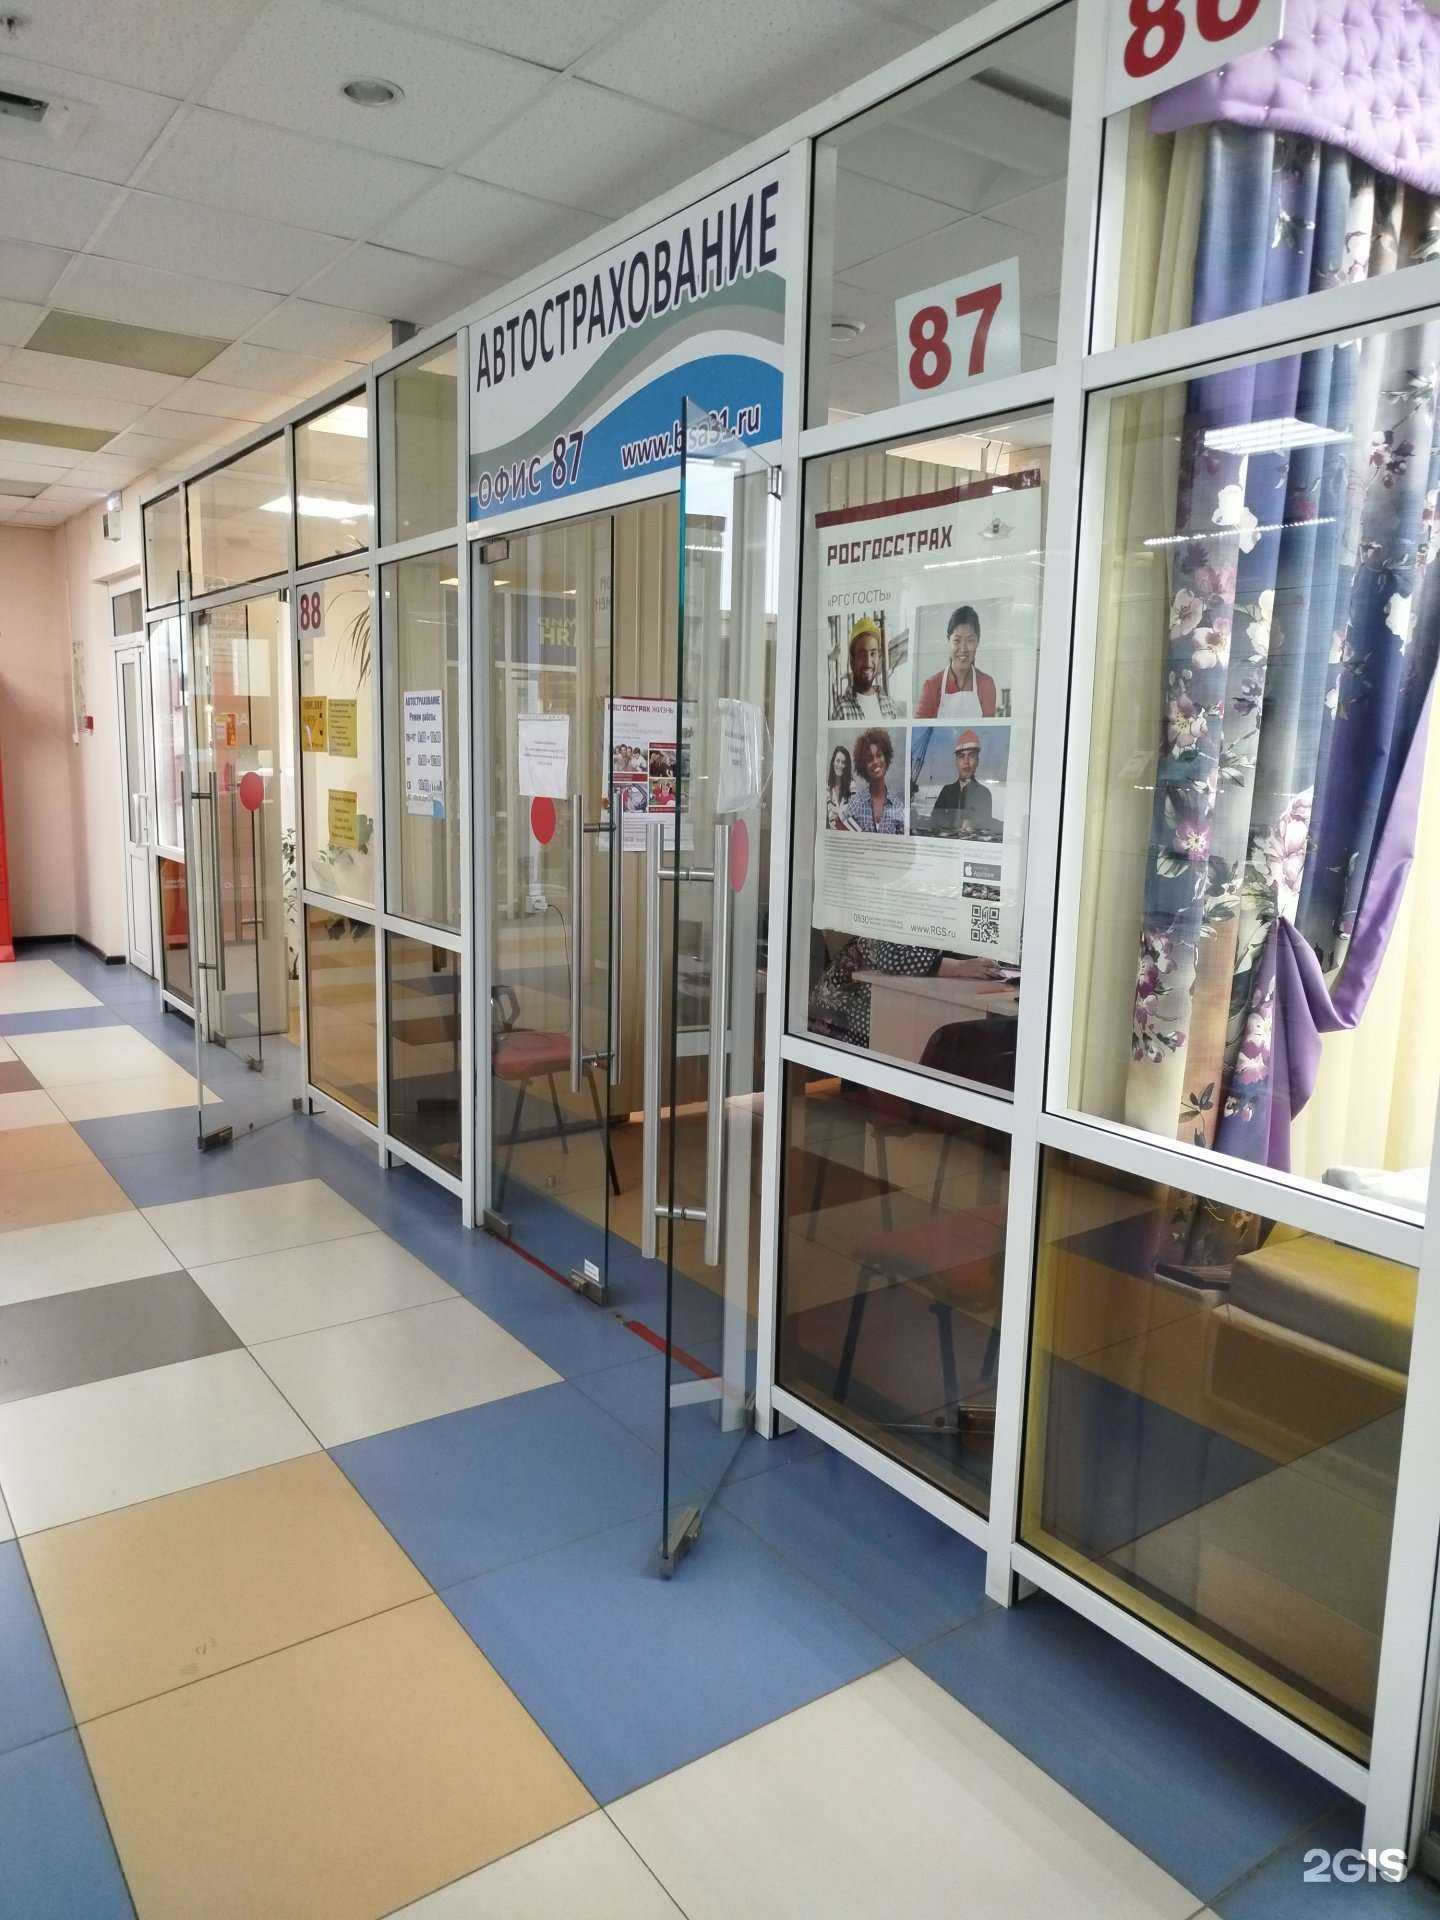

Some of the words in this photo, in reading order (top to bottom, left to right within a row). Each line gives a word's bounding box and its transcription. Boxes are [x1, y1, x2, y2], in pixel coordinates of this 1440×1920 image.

[477, 181, 779, 392] АВТОСТРАХОВАНИЕ
[909, 283, 1002, 390] 87
[478, 456, 542, 508] ОФИС
[552, 430, 584, 488] 87
[827, 525, 953, 566] РОСГОССТРАХ
[300, 591, 321, 631] 88
